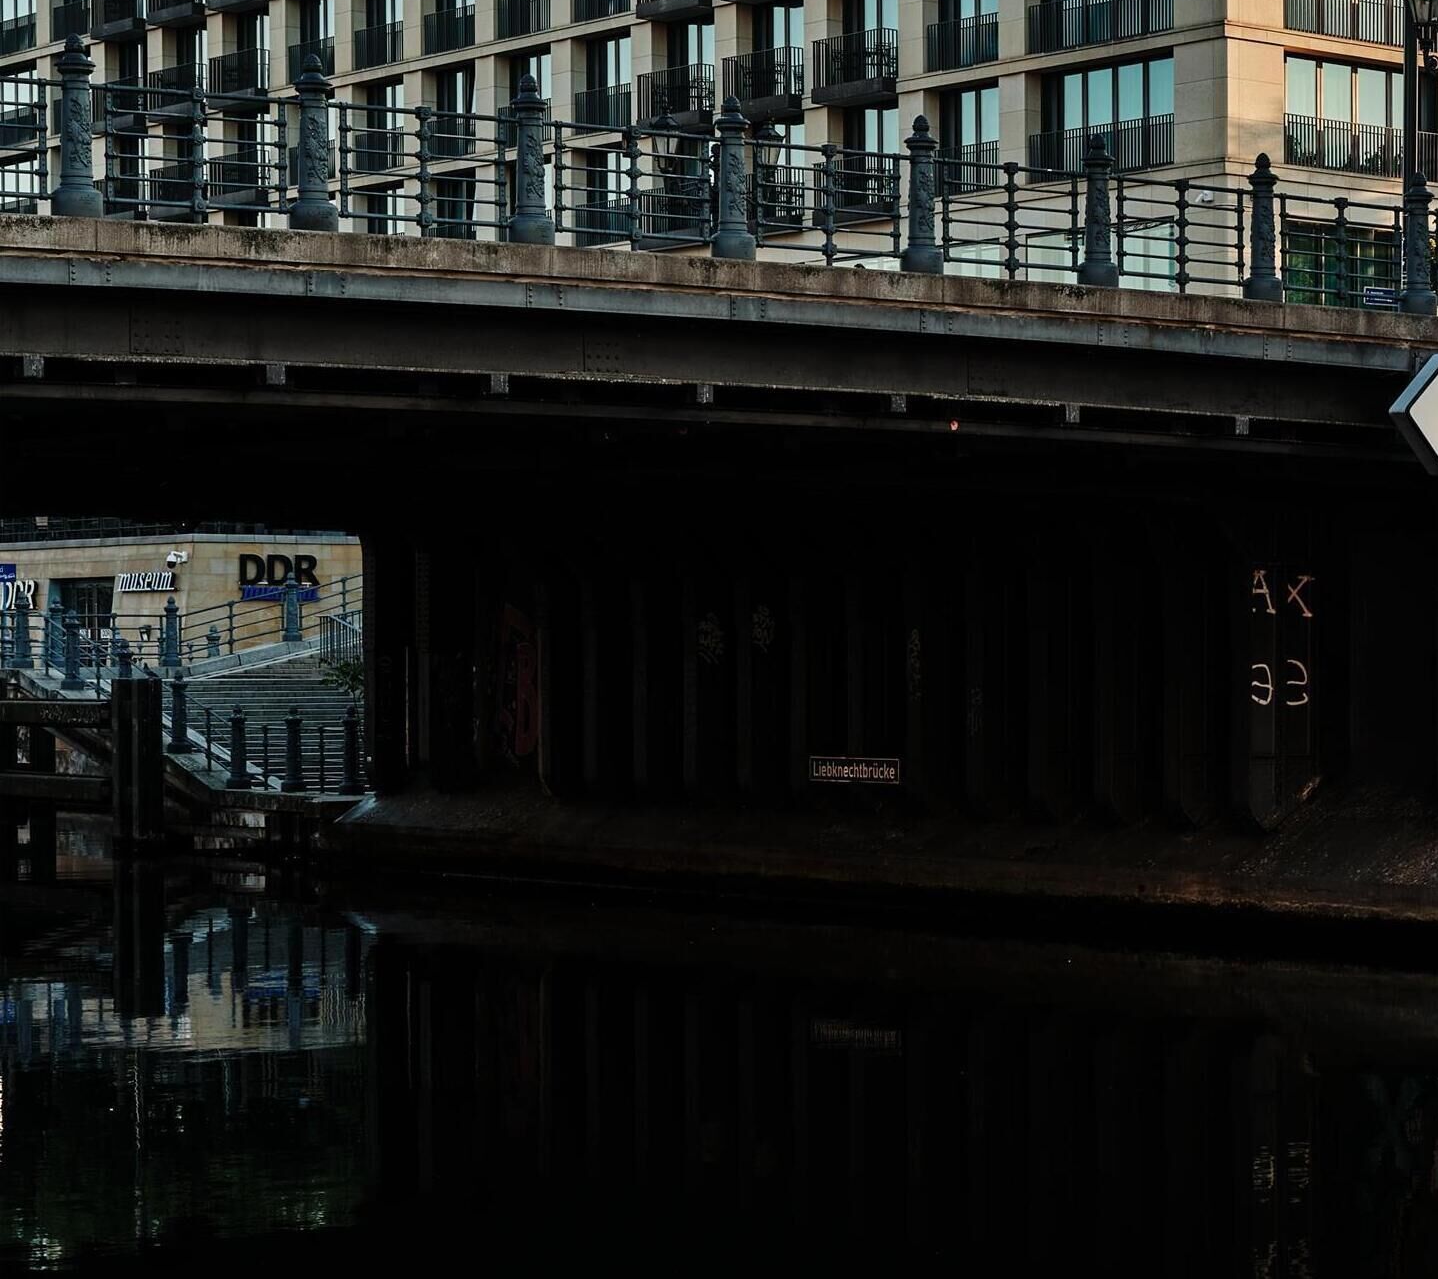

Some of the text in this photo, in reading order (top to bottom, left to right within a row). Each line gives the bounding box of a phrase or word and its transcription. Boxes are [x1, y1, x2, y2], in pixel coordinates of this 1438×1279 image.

[239, 553, 320, 586] DDR
[117, 571, 174, 592] museum
[813, 760, 896, 780] Liebknechtbrücke
